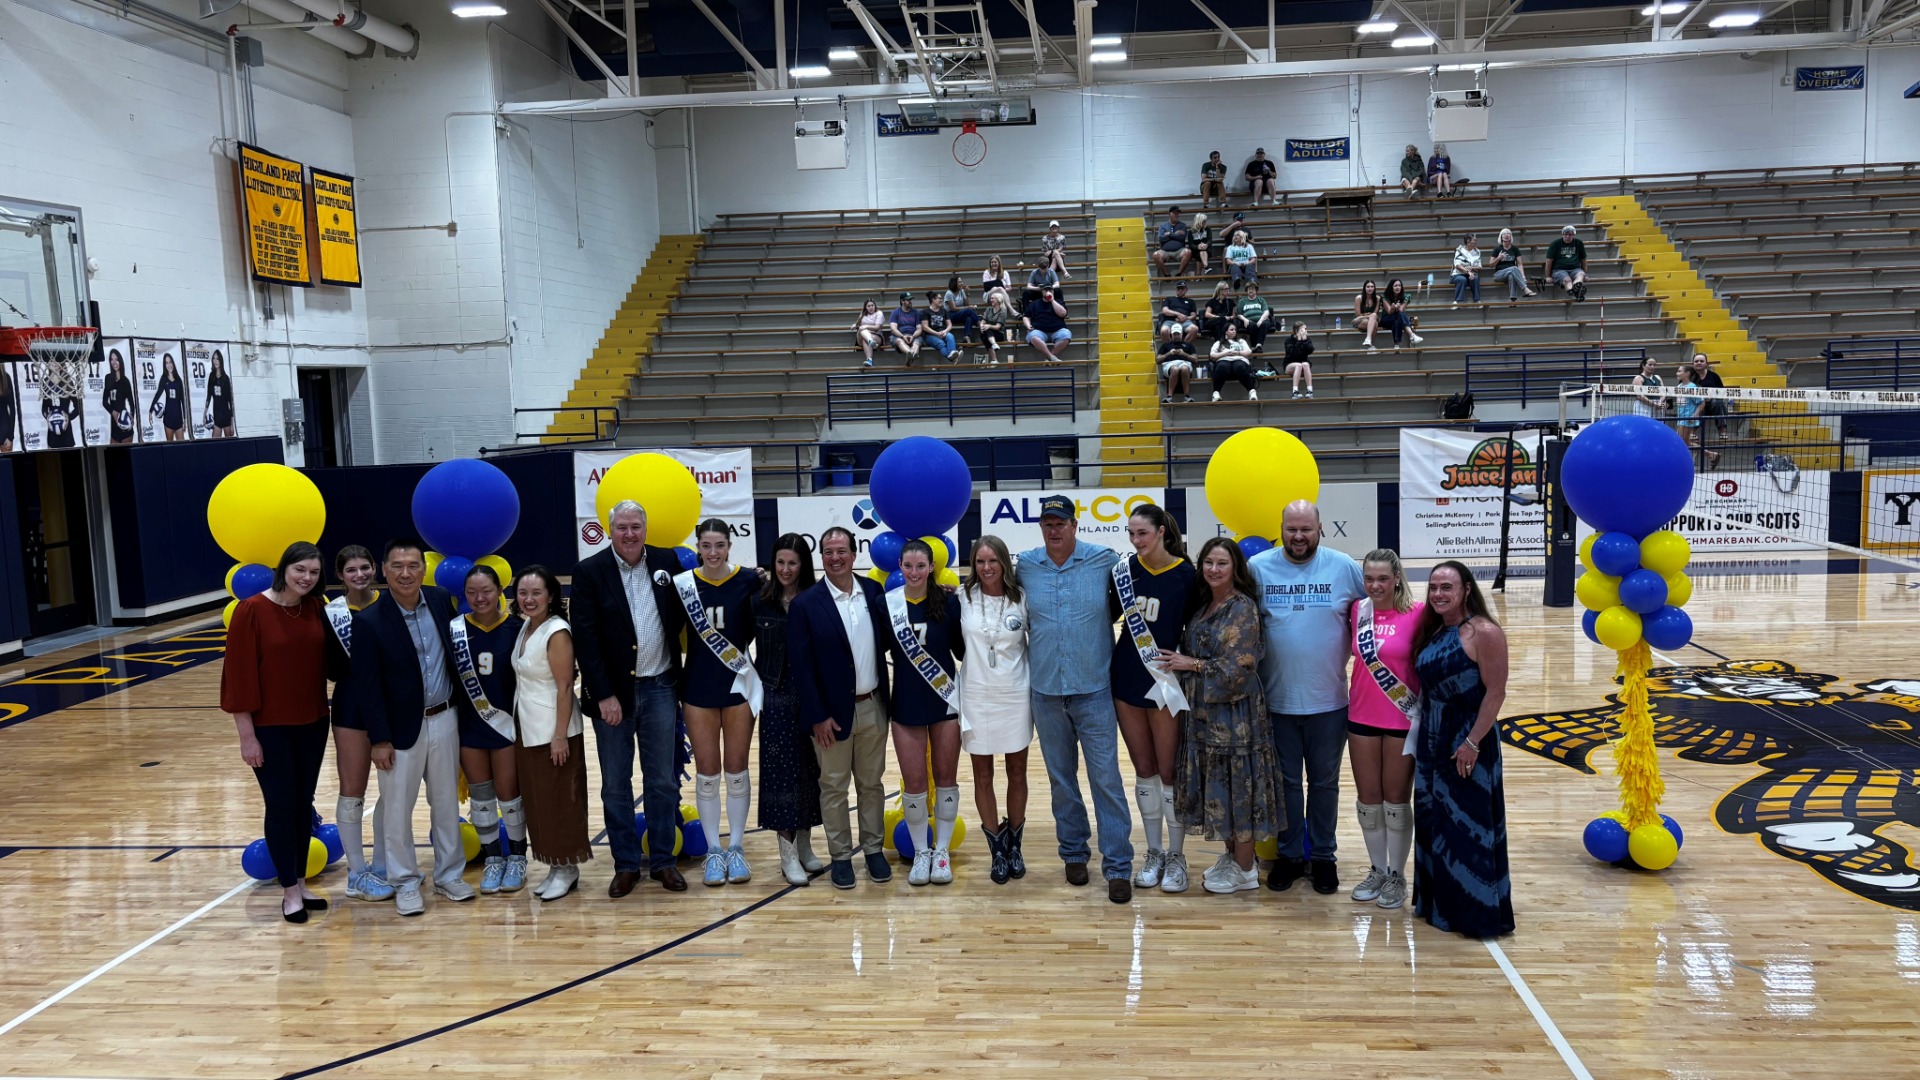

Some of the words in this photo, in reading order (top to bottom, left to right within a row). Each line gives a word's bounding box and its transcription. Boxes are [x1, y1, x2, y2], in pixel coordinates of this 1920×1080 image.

[1814, 70, 1847, 78] HOME
[1799, 78, 1861, 88] OVERFLOW
[887, 116, 928, 124] VISTOR
[1292, 140, 1344, 148] VISITOR
[1292, 148, 1344, 158] ADULTS
[244, 156, 280, 178] HIGHLAND
[282, 168, 302, 184] PARK
[137, 350, 156, 358] MOORE
[88, 361, 100, 378] 17
[142, 362, 155, 380] 19
[192, 362, 206, 378] 20
[1761, 390, 1788, 398] HIGHLAND
[1830, 392, 1850, 400] SCOTS
[1878, 392, 1914, 402] HIGHLAND
[686, 466, 736, 484] lman
[1661, 514, 1722, 532] PPORTS
[1757, 512, 1800, 530] SCOTS
[1436, 537, 1454, 546] Allie
[1456, 536, 1474, 546] Beth
[1516, 535, 1544, 544] Associ
[1686, 536, 1788, 544] CHMARKBANK.COM
[680, 584, 696, 600] Emily
[1266, 584, 1306, 595] HIGHLAND
[1308, 584, 1332, 594] PARK
[1266, 595, 1290, 604] VARSITY
[1293, 594, 1332, 603] VOLLEYBALL
[1136, 596, 1160, 622] 20
[706, 606, 725, 629] 11
[1374, 624, 1396, 636] COTS
[478, 652, 494, 675] 9
